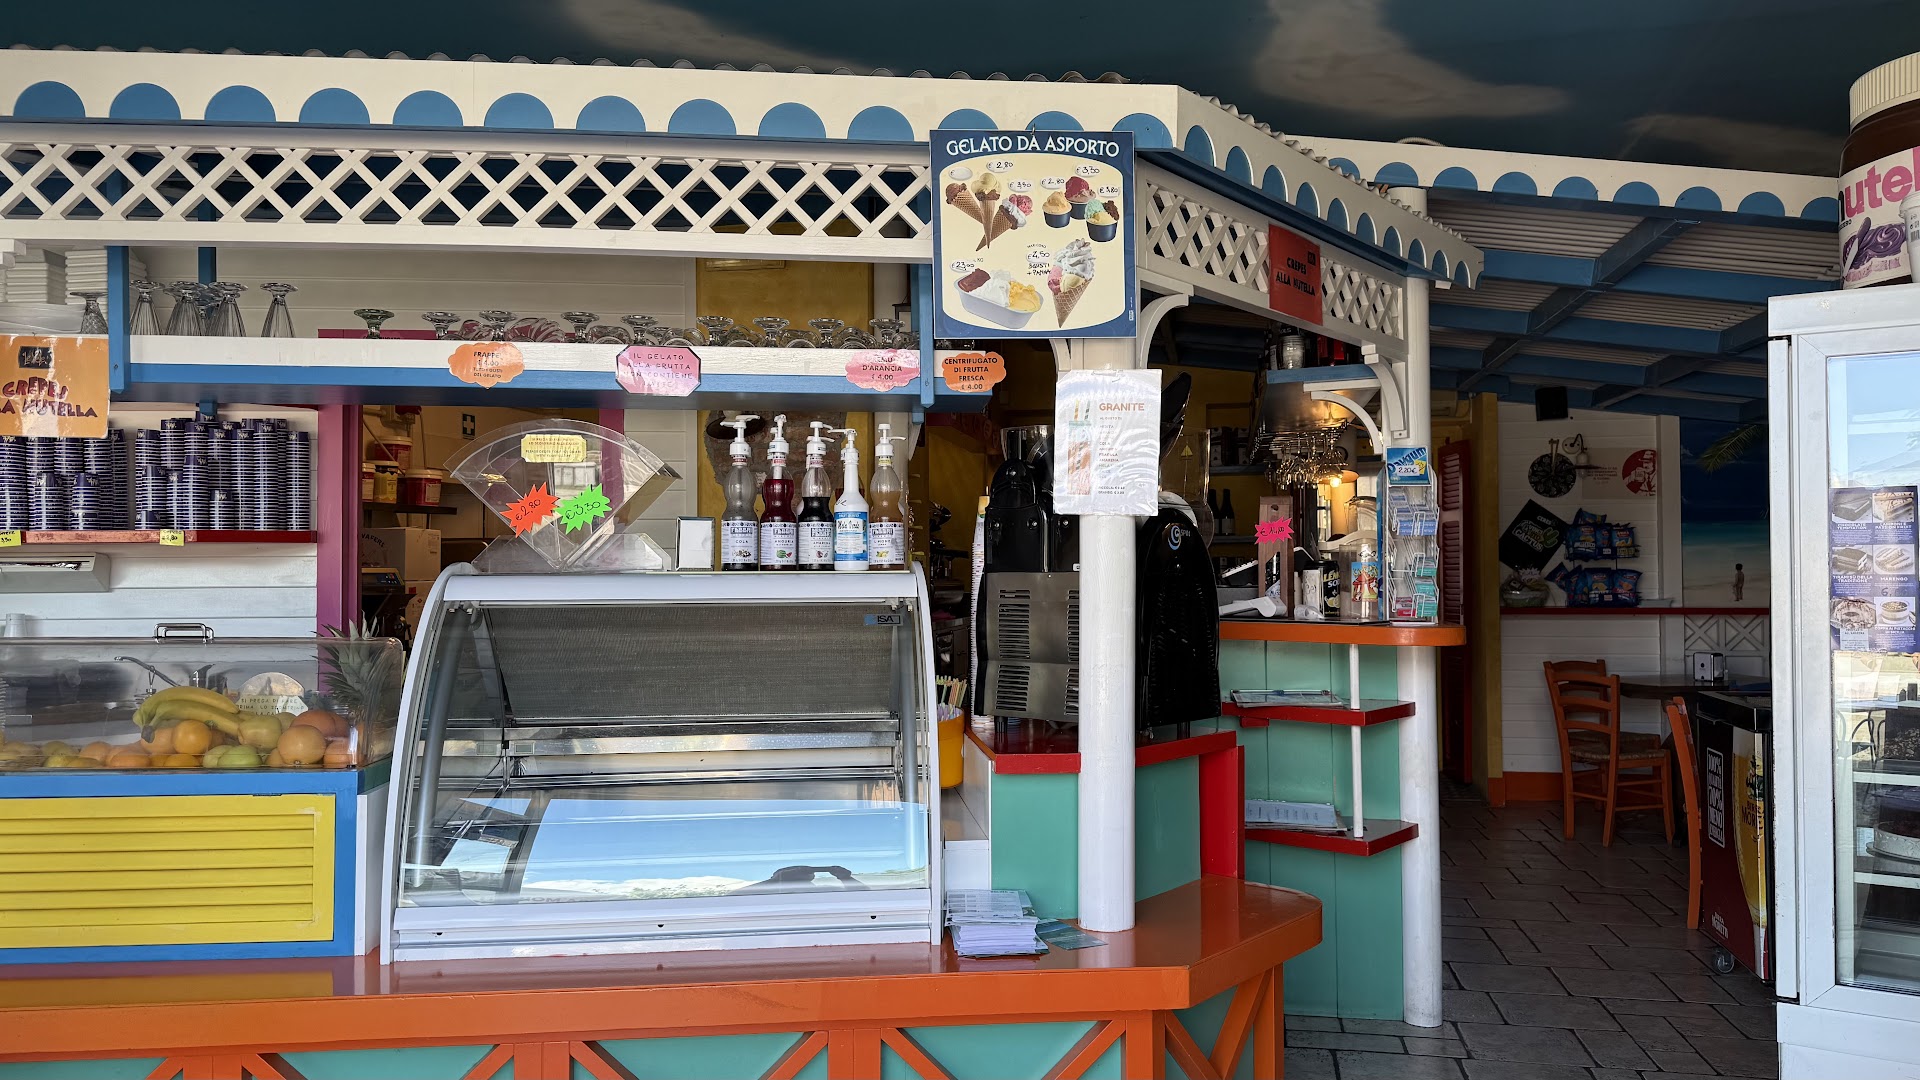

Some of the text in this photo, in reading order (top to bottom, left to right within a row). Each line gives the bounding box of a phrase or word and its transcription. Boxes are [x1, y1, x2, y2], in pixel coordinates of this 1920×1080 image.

[946, 135, 1120, 157] GELATO DA ASPORTO
[1286, 256, 1307, 275] CREPES
[1275, 271, 1316, 297] ALLA NUTELLA
[944, 356, 998, 365] CENTRIFUGATO
[862, 364, 902, 372] D'ARANCIA
[647, 371, 693, 379] CONTIENE
[2, 376, 69, 400] CREPES
[0, 399, 15, 414] A
[1099, 402, 1145, 412] GRANITE
[877, 615, 894, 623] ISA
